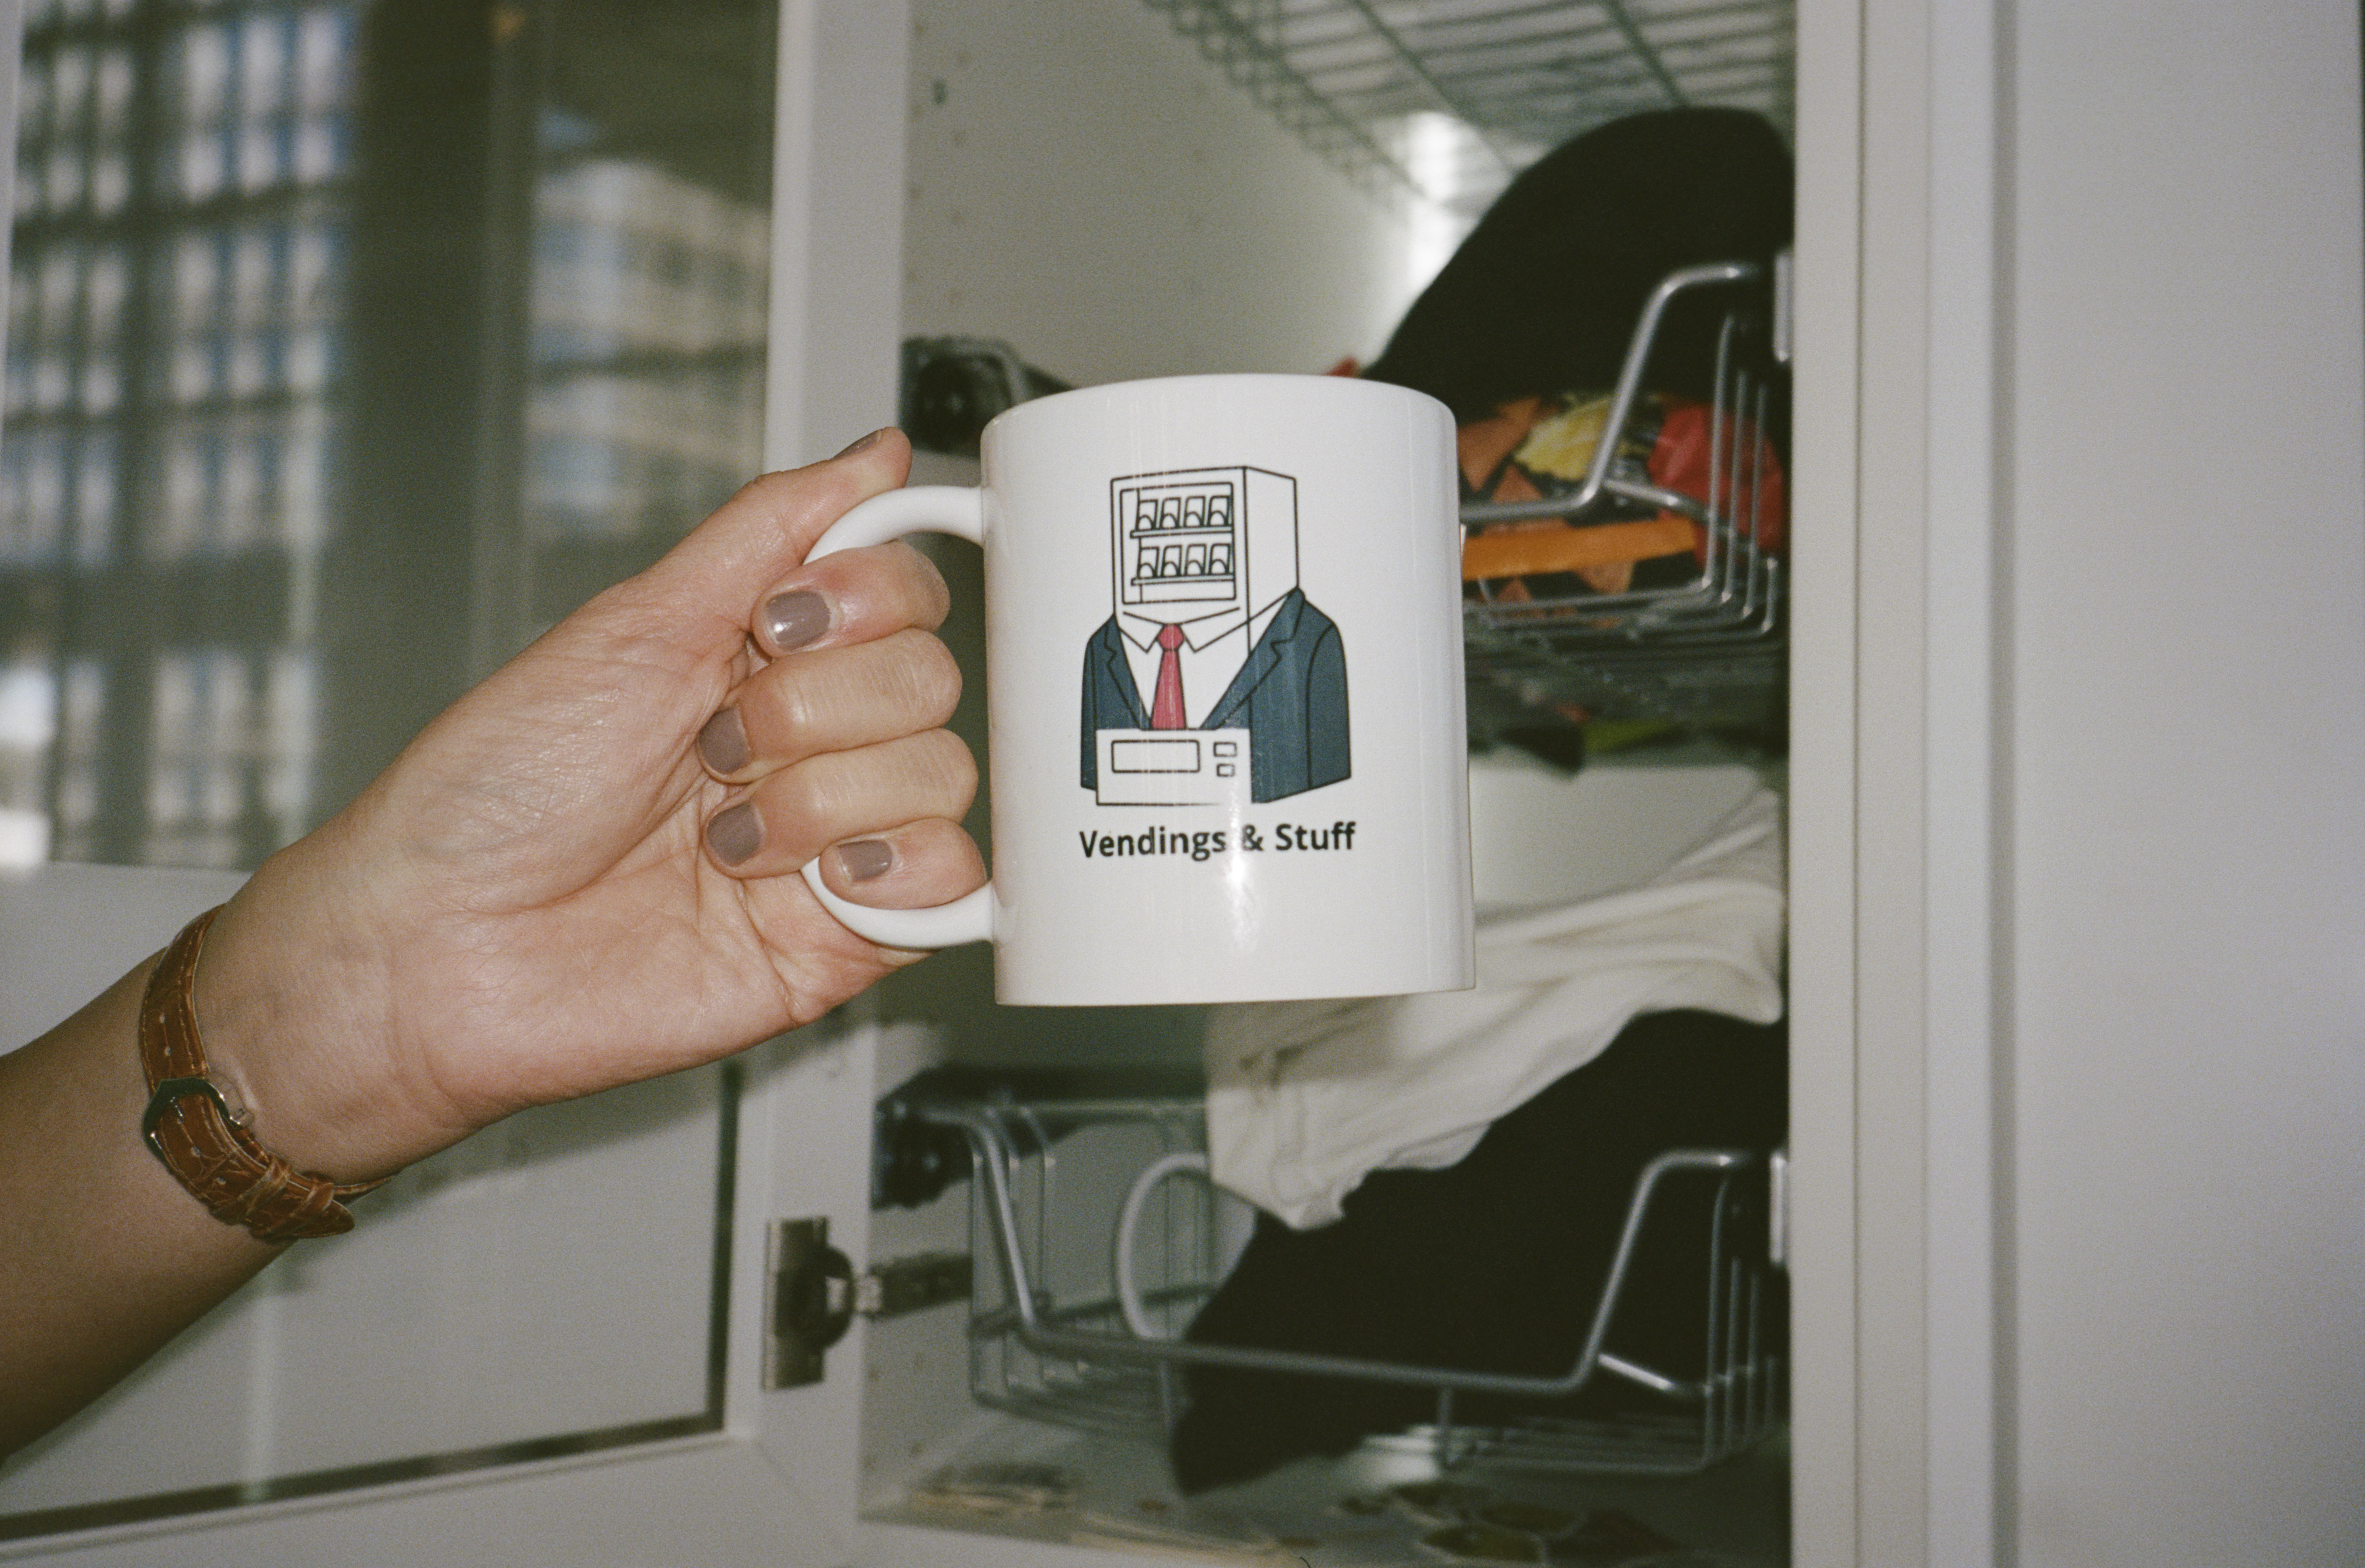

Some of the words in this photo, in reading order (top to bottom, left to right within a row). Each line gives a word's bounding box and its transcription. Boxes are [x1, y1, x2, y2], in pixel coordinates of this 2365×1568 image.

[1079, 825, 1227, 862] Vendings
[1242, 824, 1264, 851] &
[1275, 821, 1356, 851] Stuff
